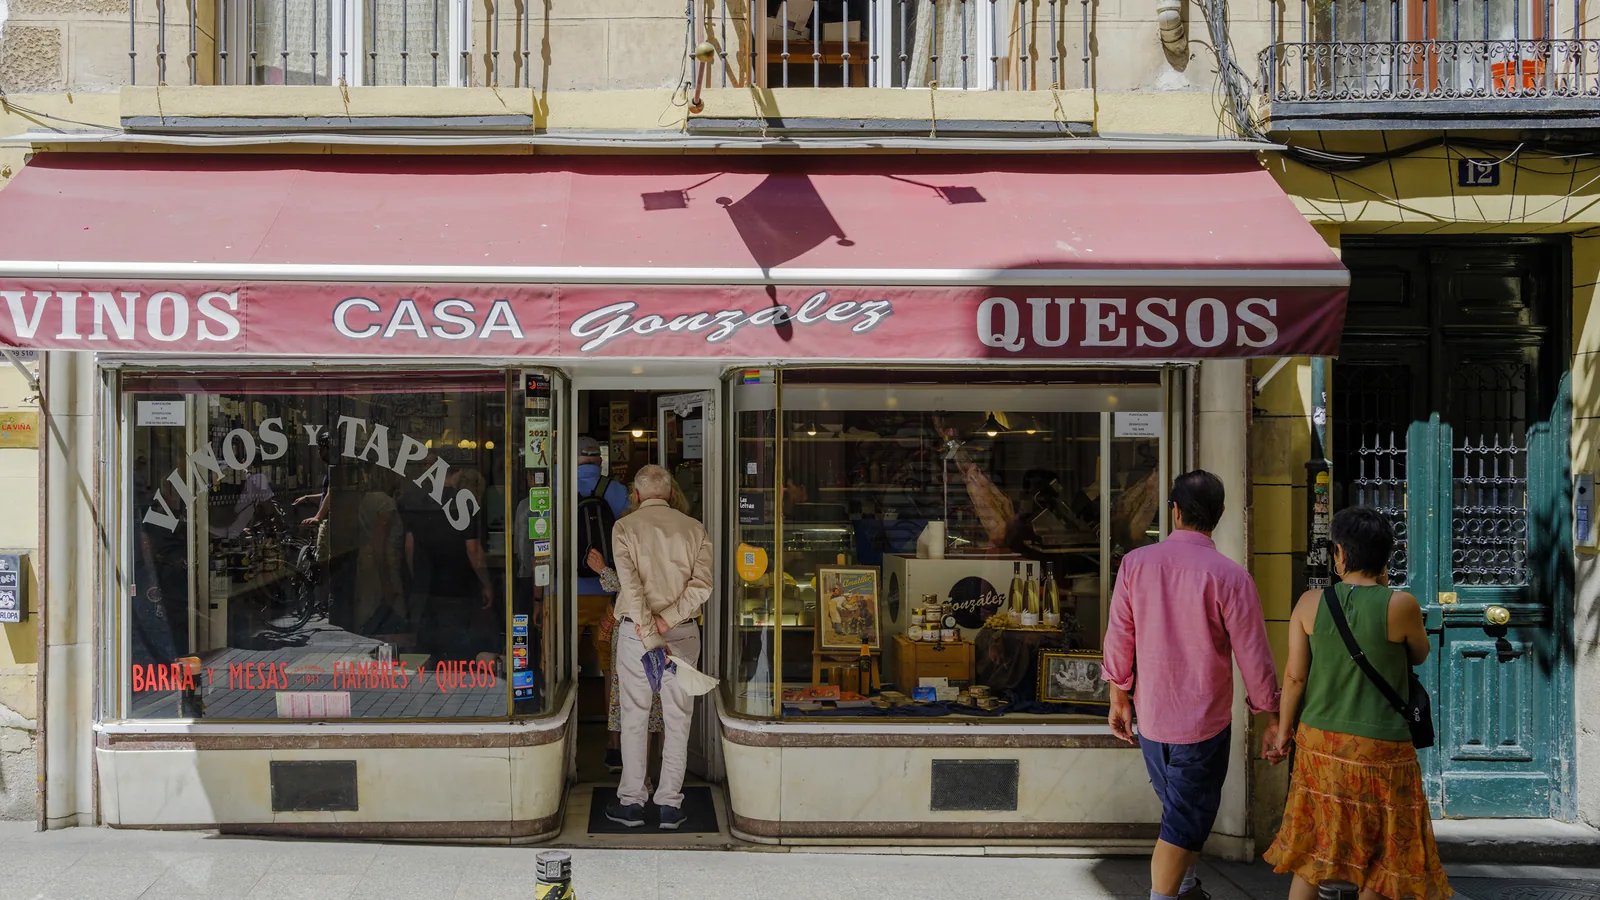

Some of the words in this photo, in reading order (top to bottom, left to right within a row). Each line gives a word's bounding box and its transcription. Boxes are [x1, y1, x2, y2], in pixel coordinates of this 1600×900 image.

[1465, 160, 1492, 185] 12
[0, 291, 241, 342] VINOS
[333, 297, 525, 340] CASA
[570, 291, 893, 352] Gonzalez
[976, 297, 1279, 352] QUESOS
[12, 422, 31, 431] VIÑA
[143, 417, 288, 534] VINOS
[304, 424, 323, 446] Y
[337, 415, 481, 532] TAPAS
[946, 590, 1007, 613] onzález
[132, 662, 195, 692] BARRA
[230, 661, 289, 691] MESAS
[333, 660, 409, 690] FIAMBRES
[436, 660, 496, 693] QUESOS
